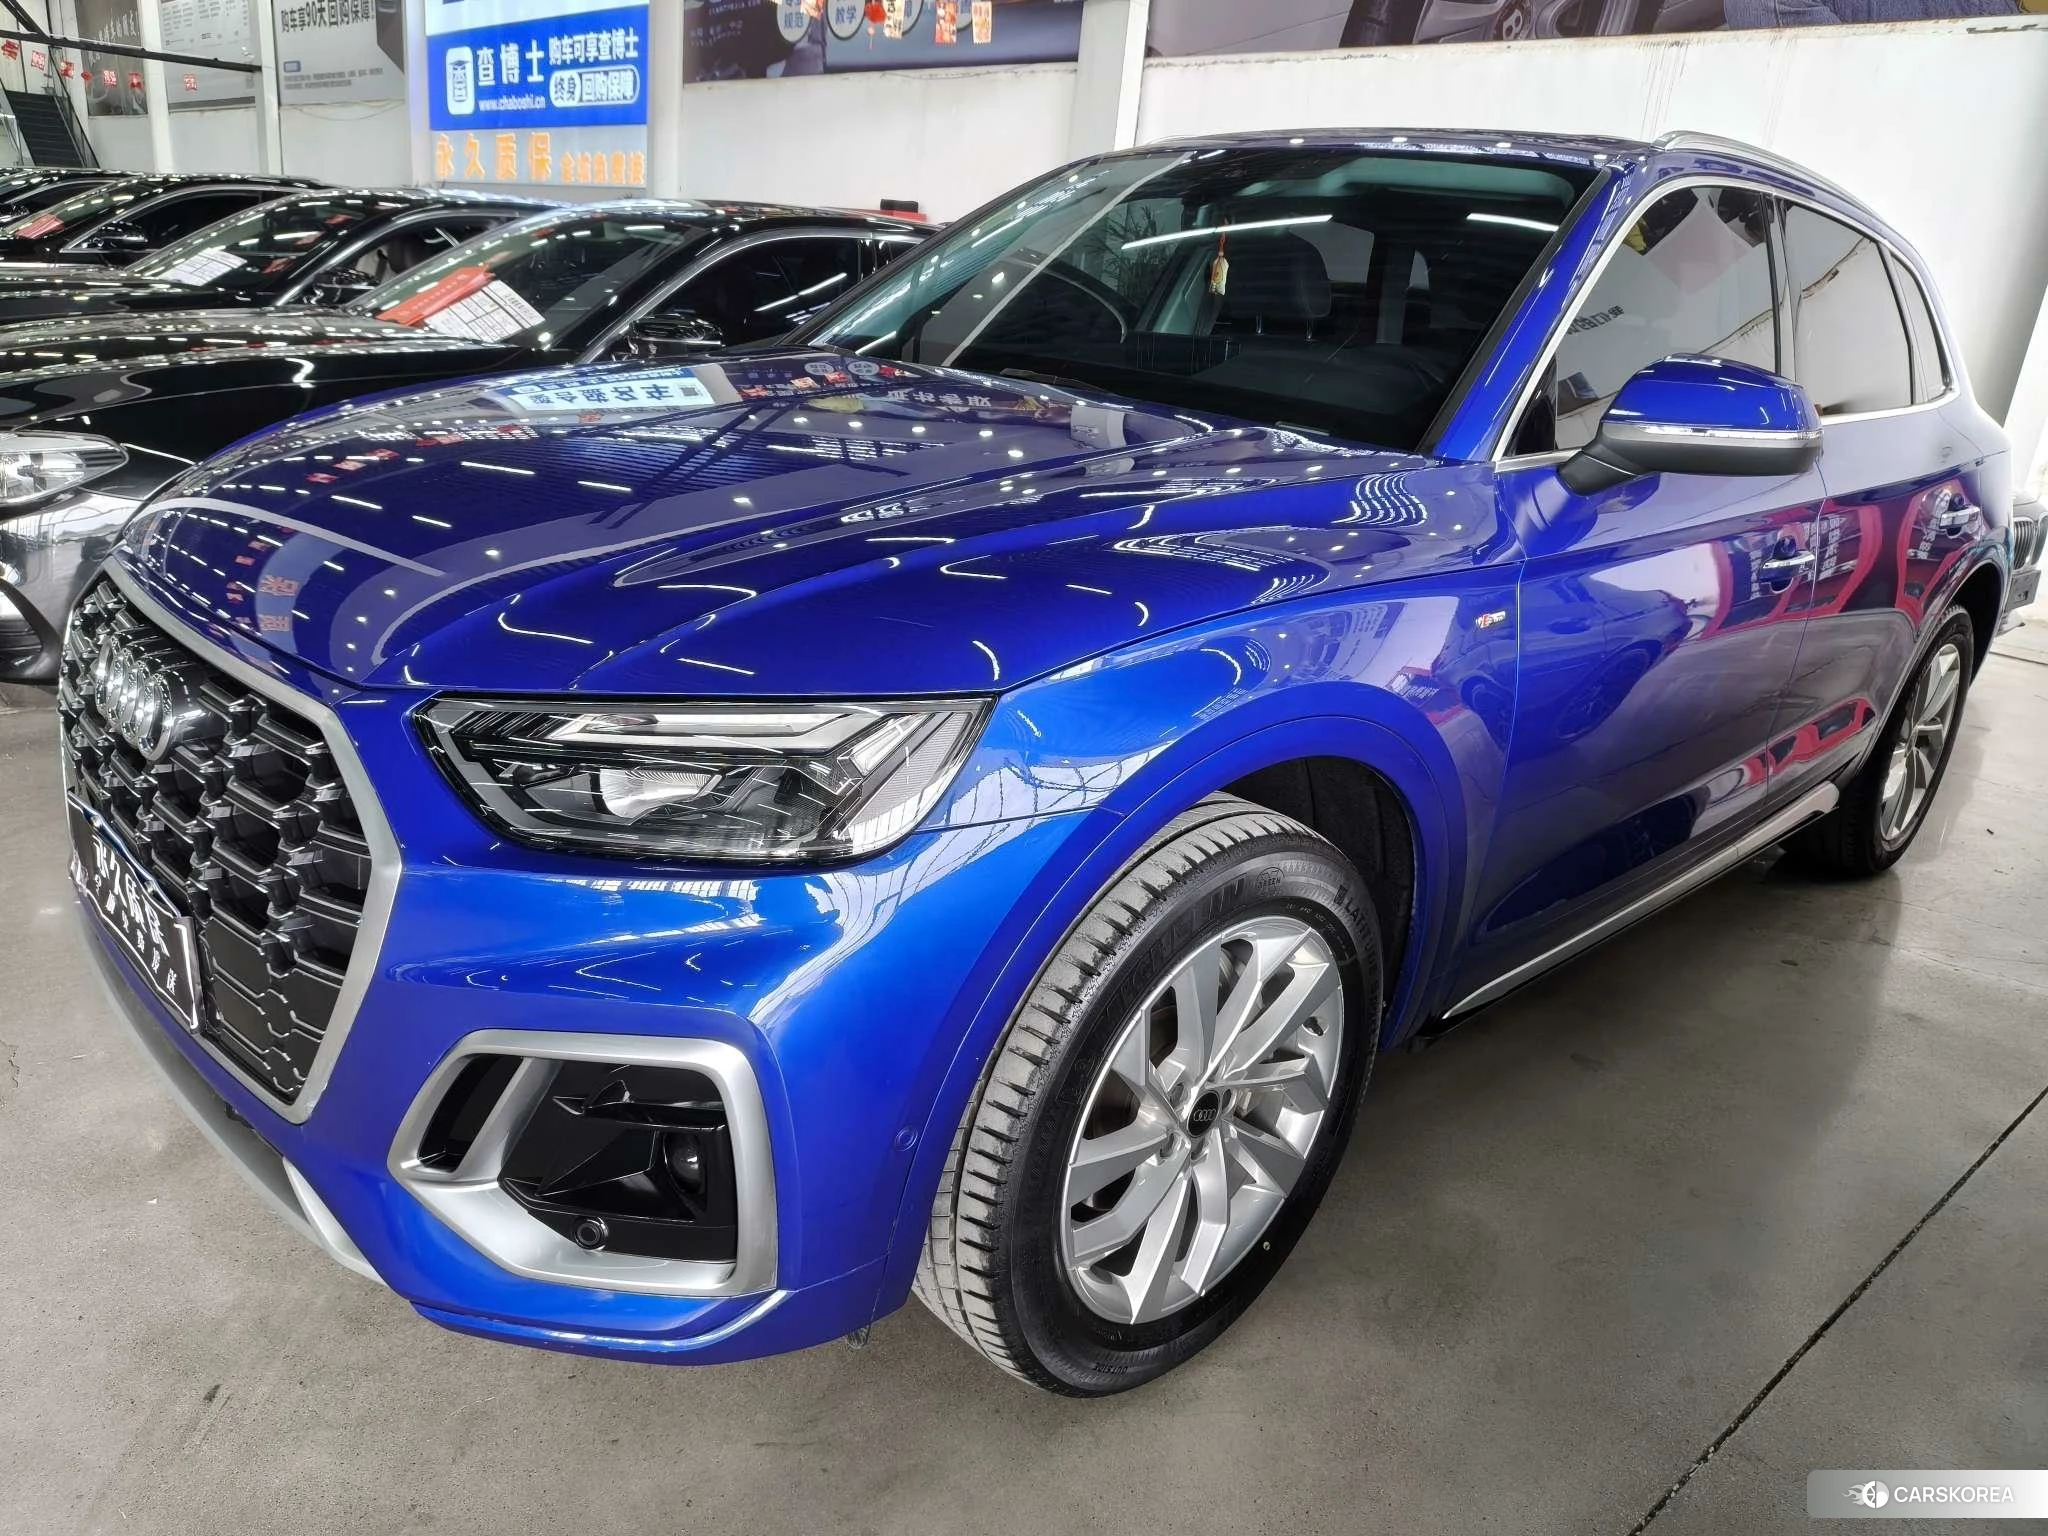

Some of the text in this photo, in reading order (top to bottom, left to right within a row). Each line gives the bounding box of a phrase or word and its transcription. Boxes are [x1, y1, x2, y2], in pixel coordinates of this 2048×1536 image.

[477, 40, 544, 86] 查博士
[549, 27, 639, 65] 购车可享查博士
